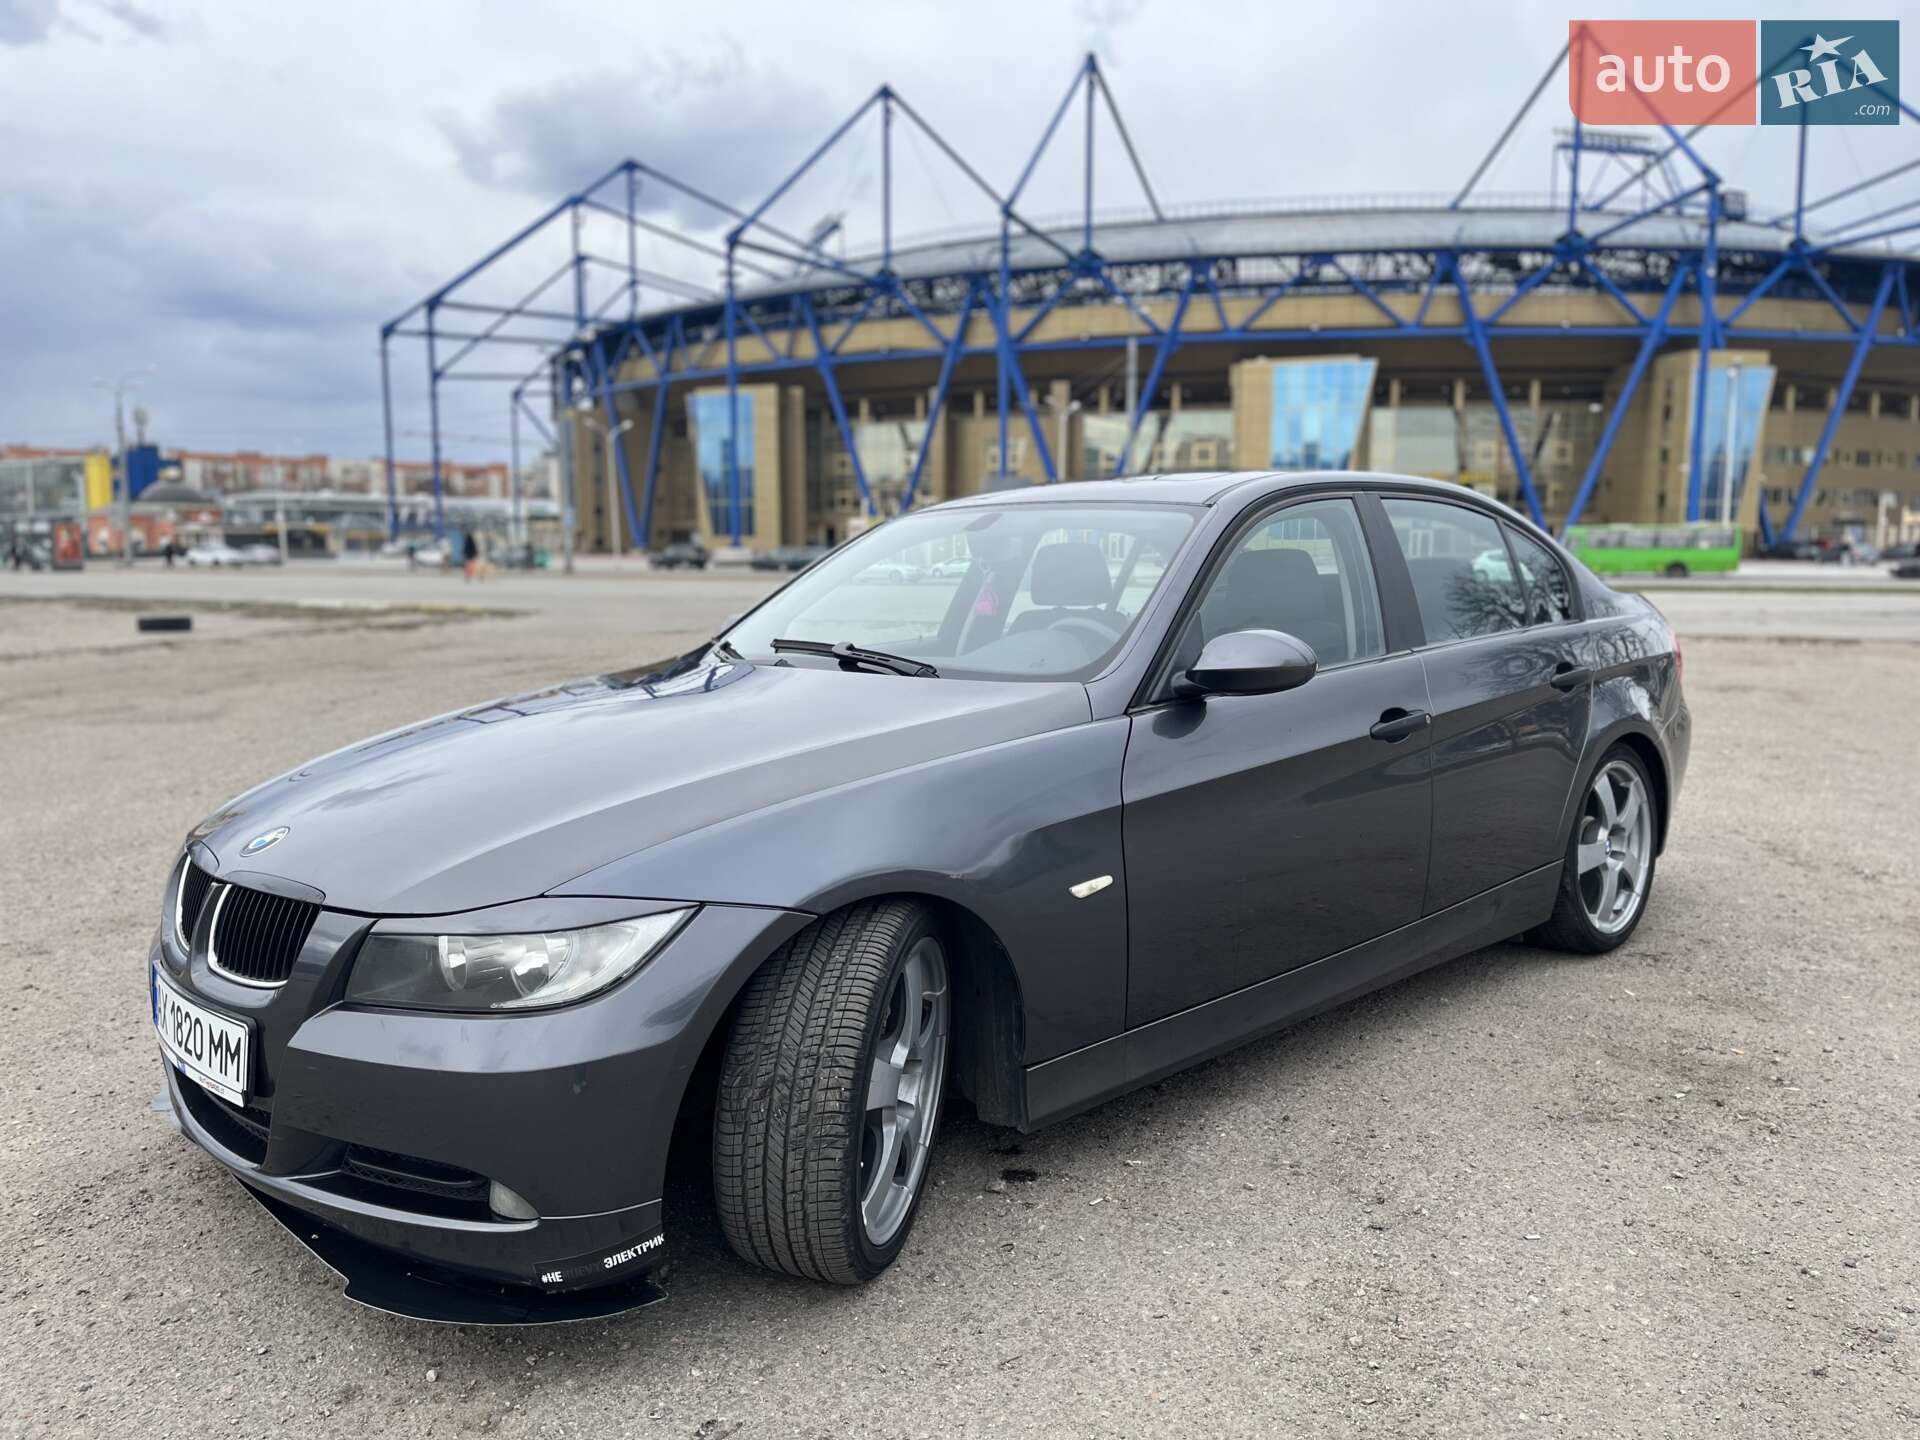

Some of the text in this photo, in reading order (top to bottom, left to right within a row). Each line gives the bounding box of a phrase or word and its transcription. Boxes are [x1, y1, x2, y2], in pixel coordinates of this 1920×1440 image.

[170, 1000, 204, 1061] 1820
[208, 1023, 242, 1083] MM
[603, 1233, 665, 1269] ЭЛЕКТРИК
